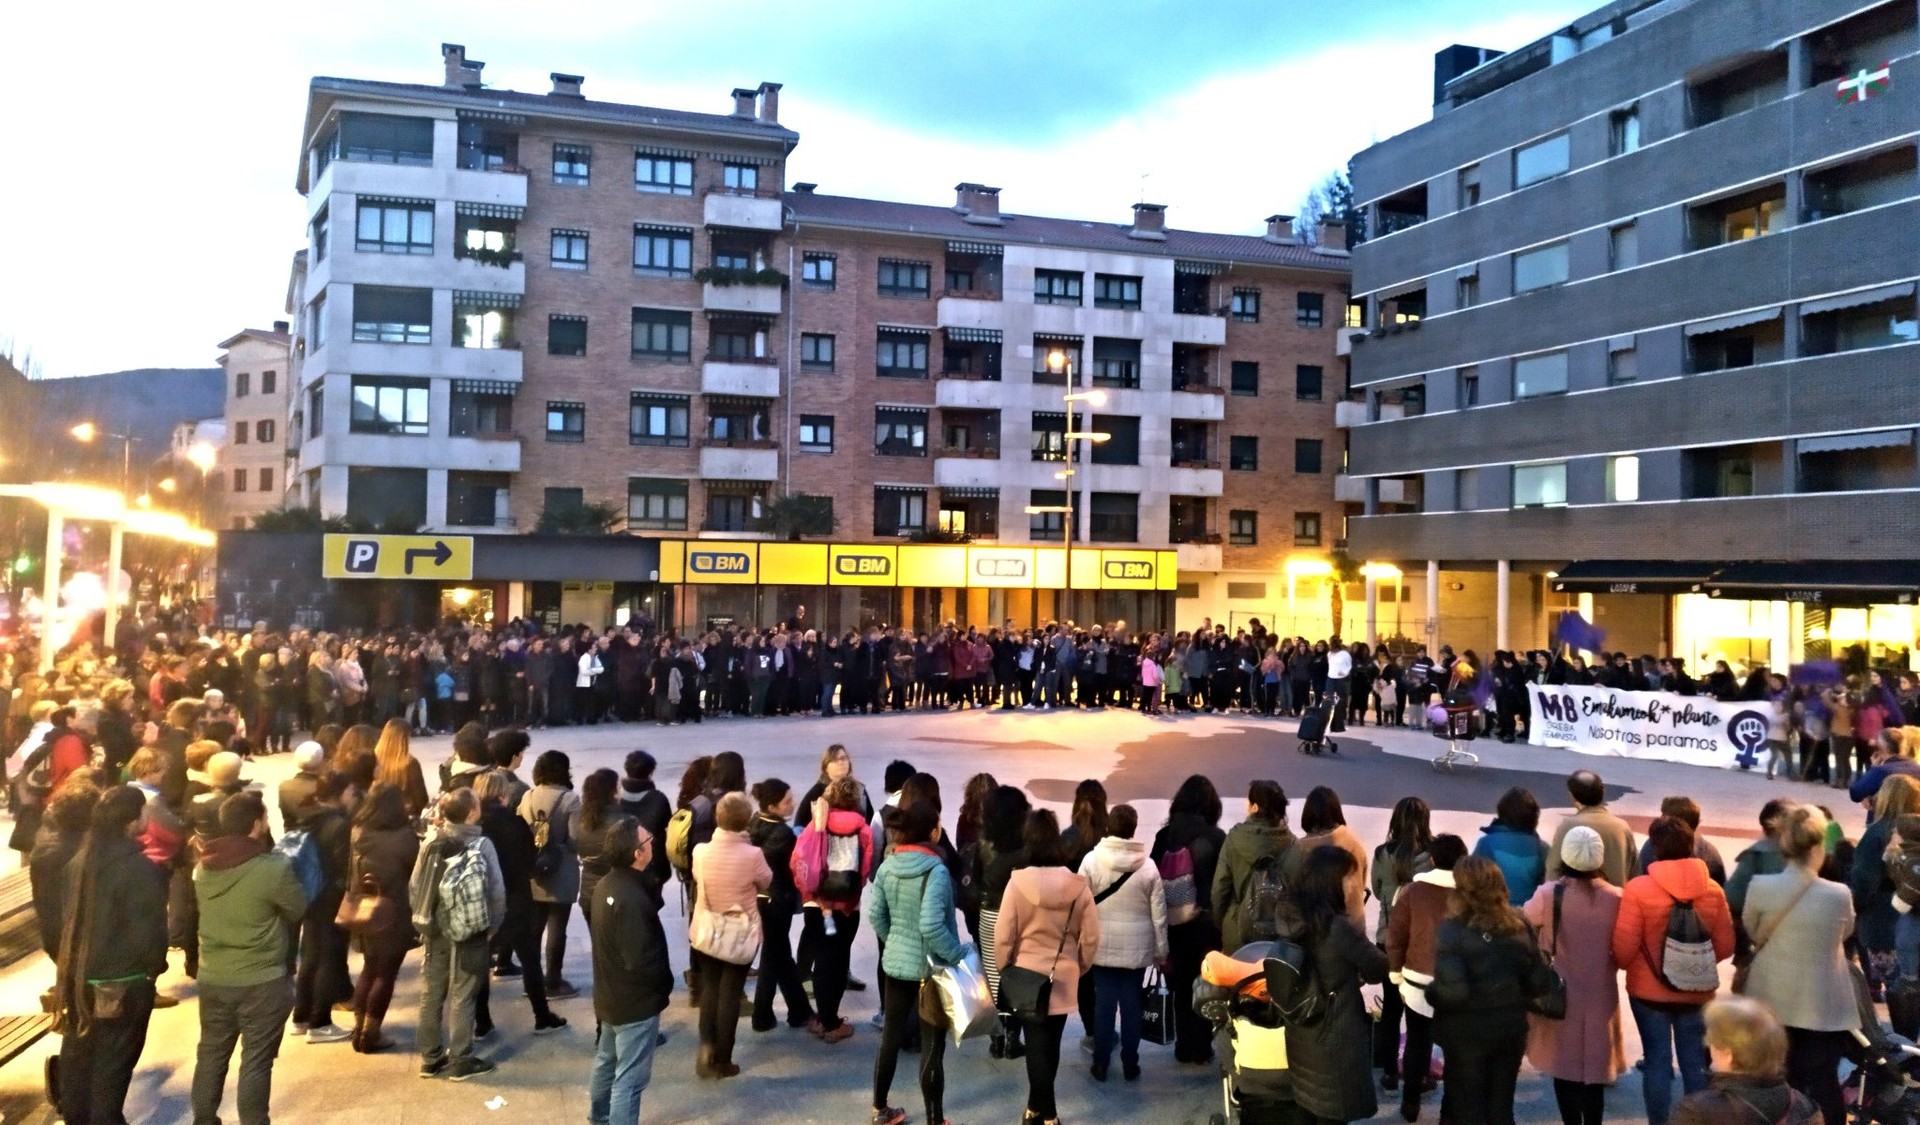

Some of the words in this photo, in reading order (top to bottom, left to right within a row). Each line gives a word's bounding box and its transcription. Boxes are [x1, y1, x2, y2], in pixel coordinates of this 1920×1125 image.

[352, 544, 374, 569] P
[715, 556, 745, 570] BM
[858, 558, 887, 573] BM
[1123, 563, 1150, 578] BM
[1537, 691, 1579, 723] M8
[1672, 703, 1722, 728] planto
[1588, 725, 1641, 745] Nosotras
[1646, 733, 1718, 752] paramos
